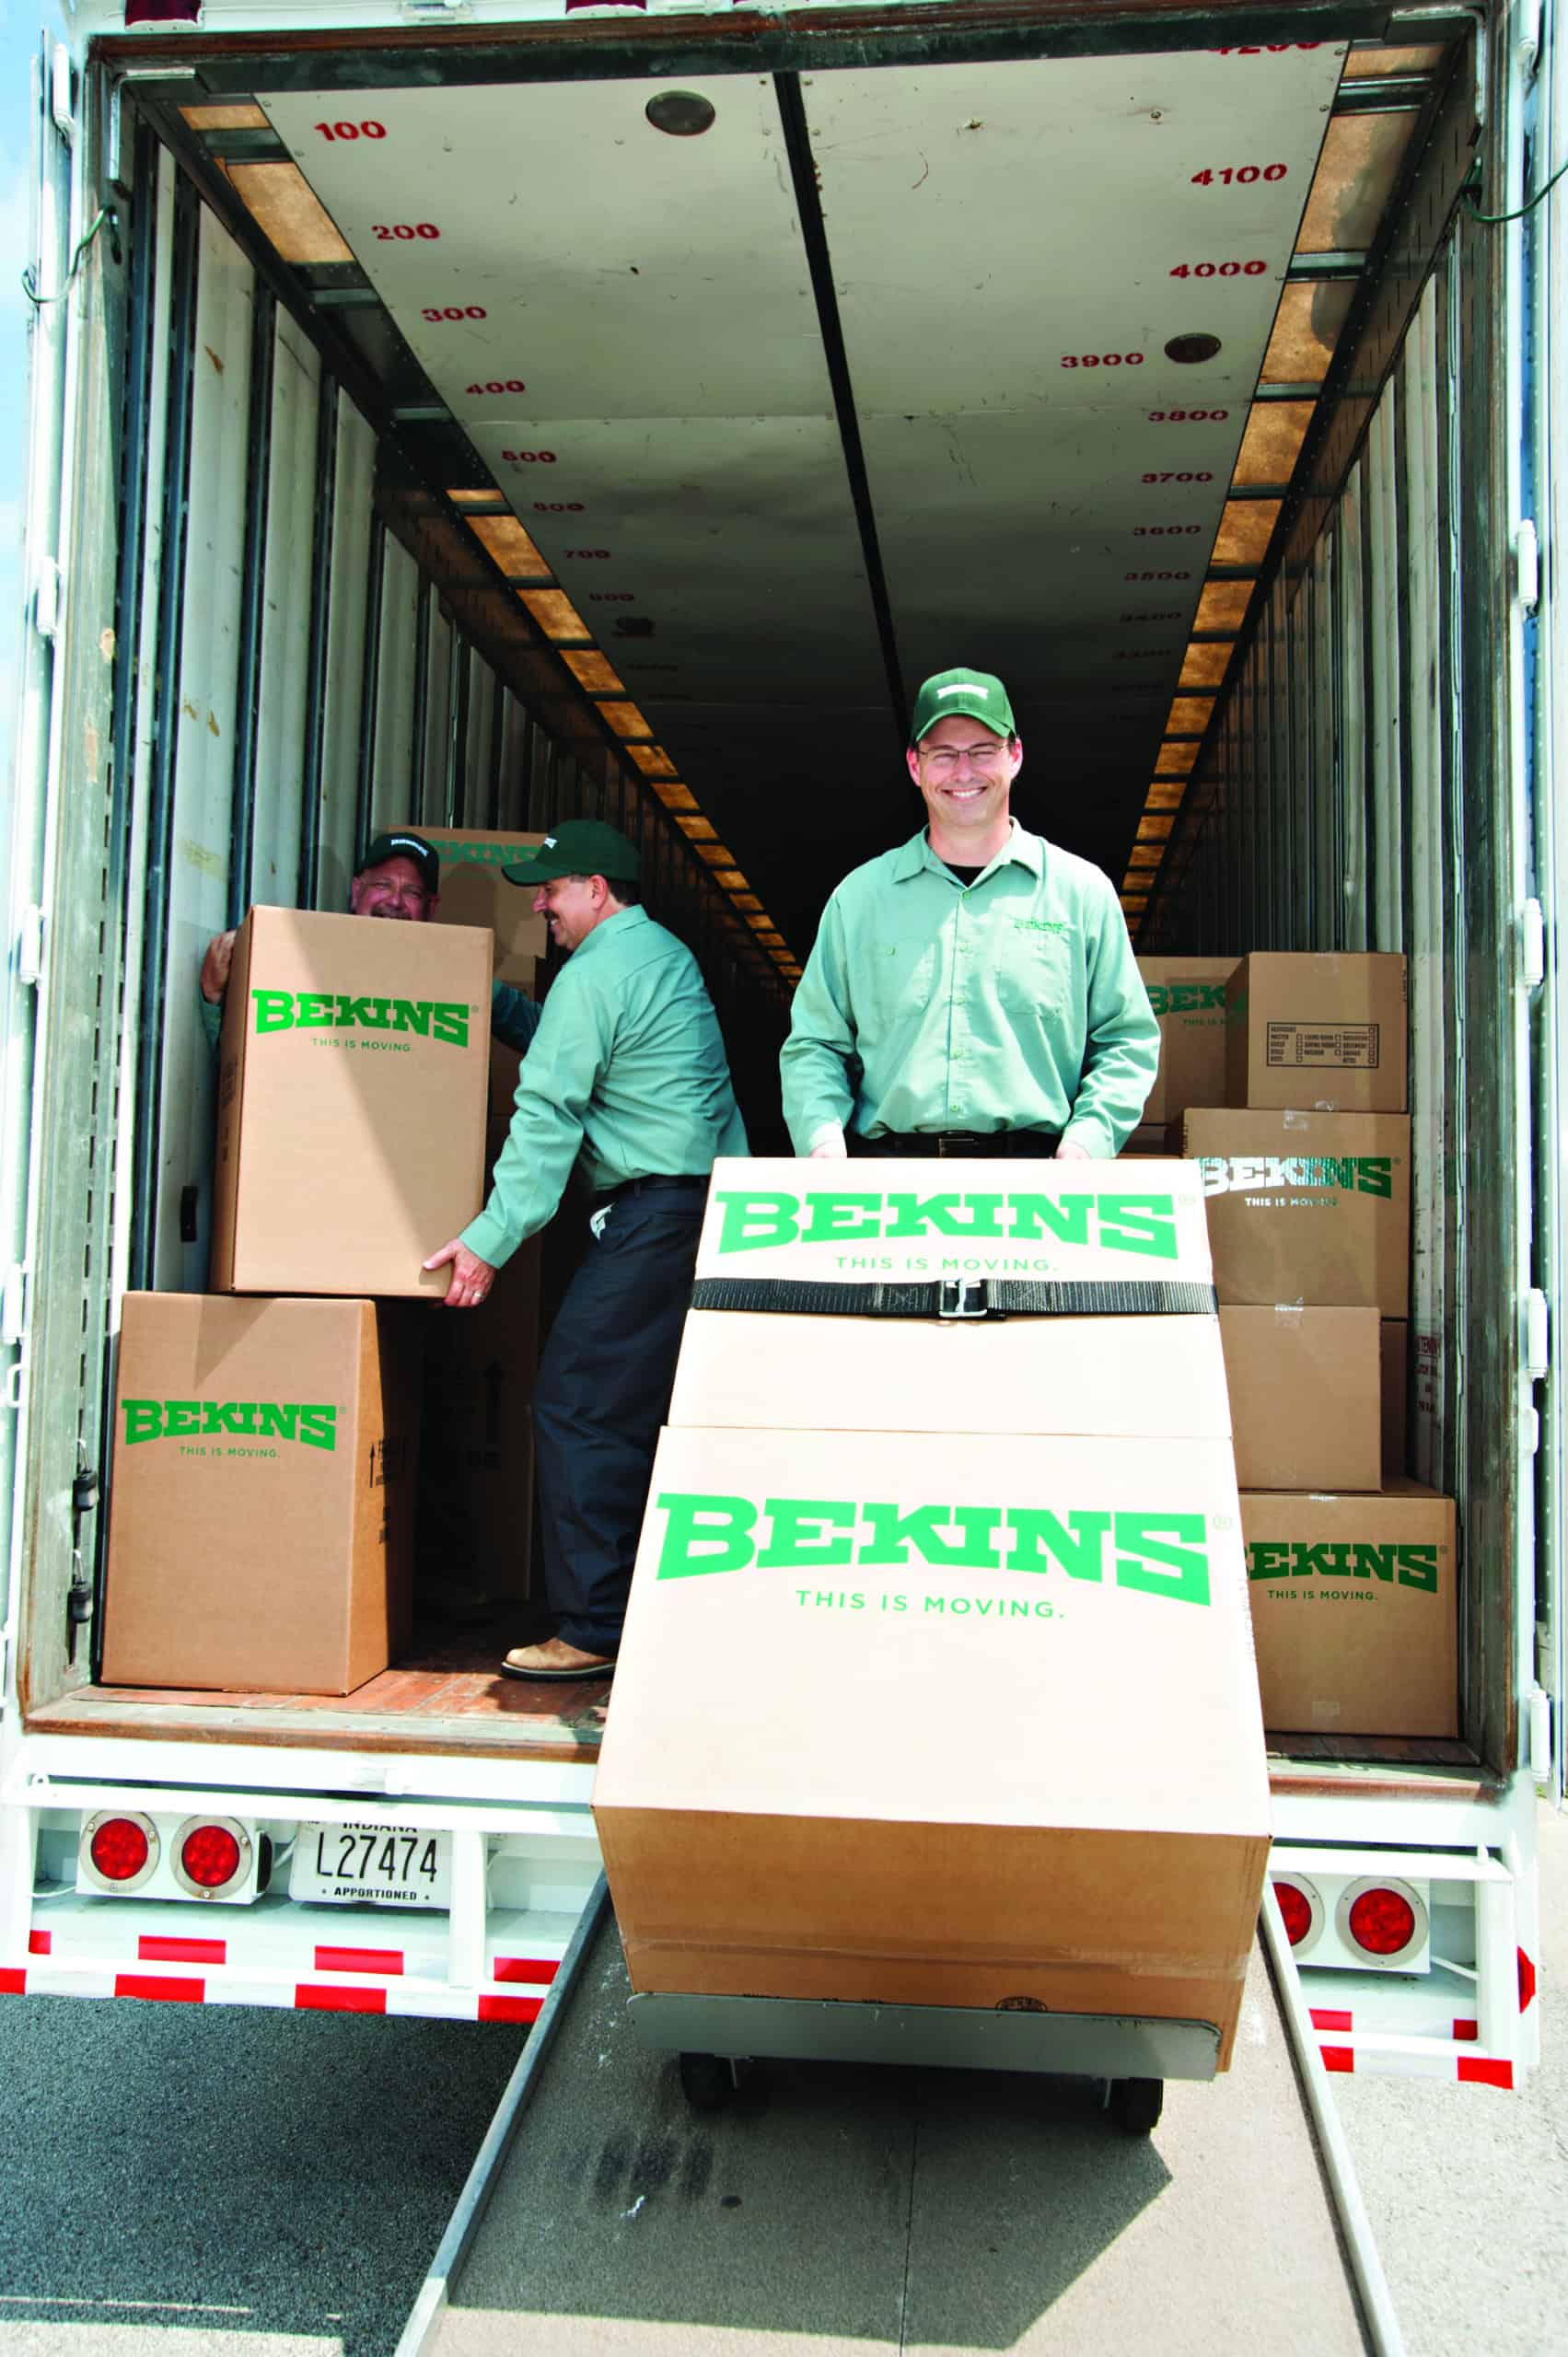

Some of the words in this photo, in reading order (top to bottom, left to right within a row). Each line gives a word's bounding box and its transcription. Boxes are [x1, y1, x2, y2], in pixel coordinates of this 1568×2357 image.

[313, 120, 388, 142] 100
[1190, 163, 1288, 186] 4100
[370, 223, 441, 240] 200
[1167, 260, 1268, 279] 4000
[421, 306, 488, 323] 300
[1060, 352, 1145, 369] 3900
[465, 379, 527, 395] 400
[1147, 409, 1230, 423] 3800
[1140, 471, 1214, 484] 3700
[1145, 985, 1226, 1016] BEK
[250, 989, 470, 1049] BEKINS
[312, 1038, 340, 1048] THIS
[344, 1039, 356, 1049] IS
[1194, 1155, 1393, 1201] BEKINS
[1244, 1197, 1272, 1208] THIS
[1274, 1197, 1287, 1208] IS
[714, 1190, 1179, 1260] BEKINS
[835, 1257, 893, 1270] THIS
[905, 1258, 929, 1271] IS
[941, 1258, 1059, 1271] MOVING.
[121, 1399, 337, 1452] BEKINS
[178, 1446, 207, 1457] THIS
[211, 1446, 223, 1457] IS
[655, 1492, 1212, 1608] BEKINS
[1245, 1541, 1438, 1594] EKINS
[1267, 1589, 1297, 1600] THIS
[1303, 1590, 1315, 1600] IS
[1319, 1590, 1379, 1601] MOVING.
[794, 1589, 866, 1610] THIS
[880, 1594, 910, 1612] IS
[923, 1596, 1065, 1620] MOVING.
[316, 1831, 437, 1884] L27474
[333, 1887, 418, 1901] APPORTIONED
